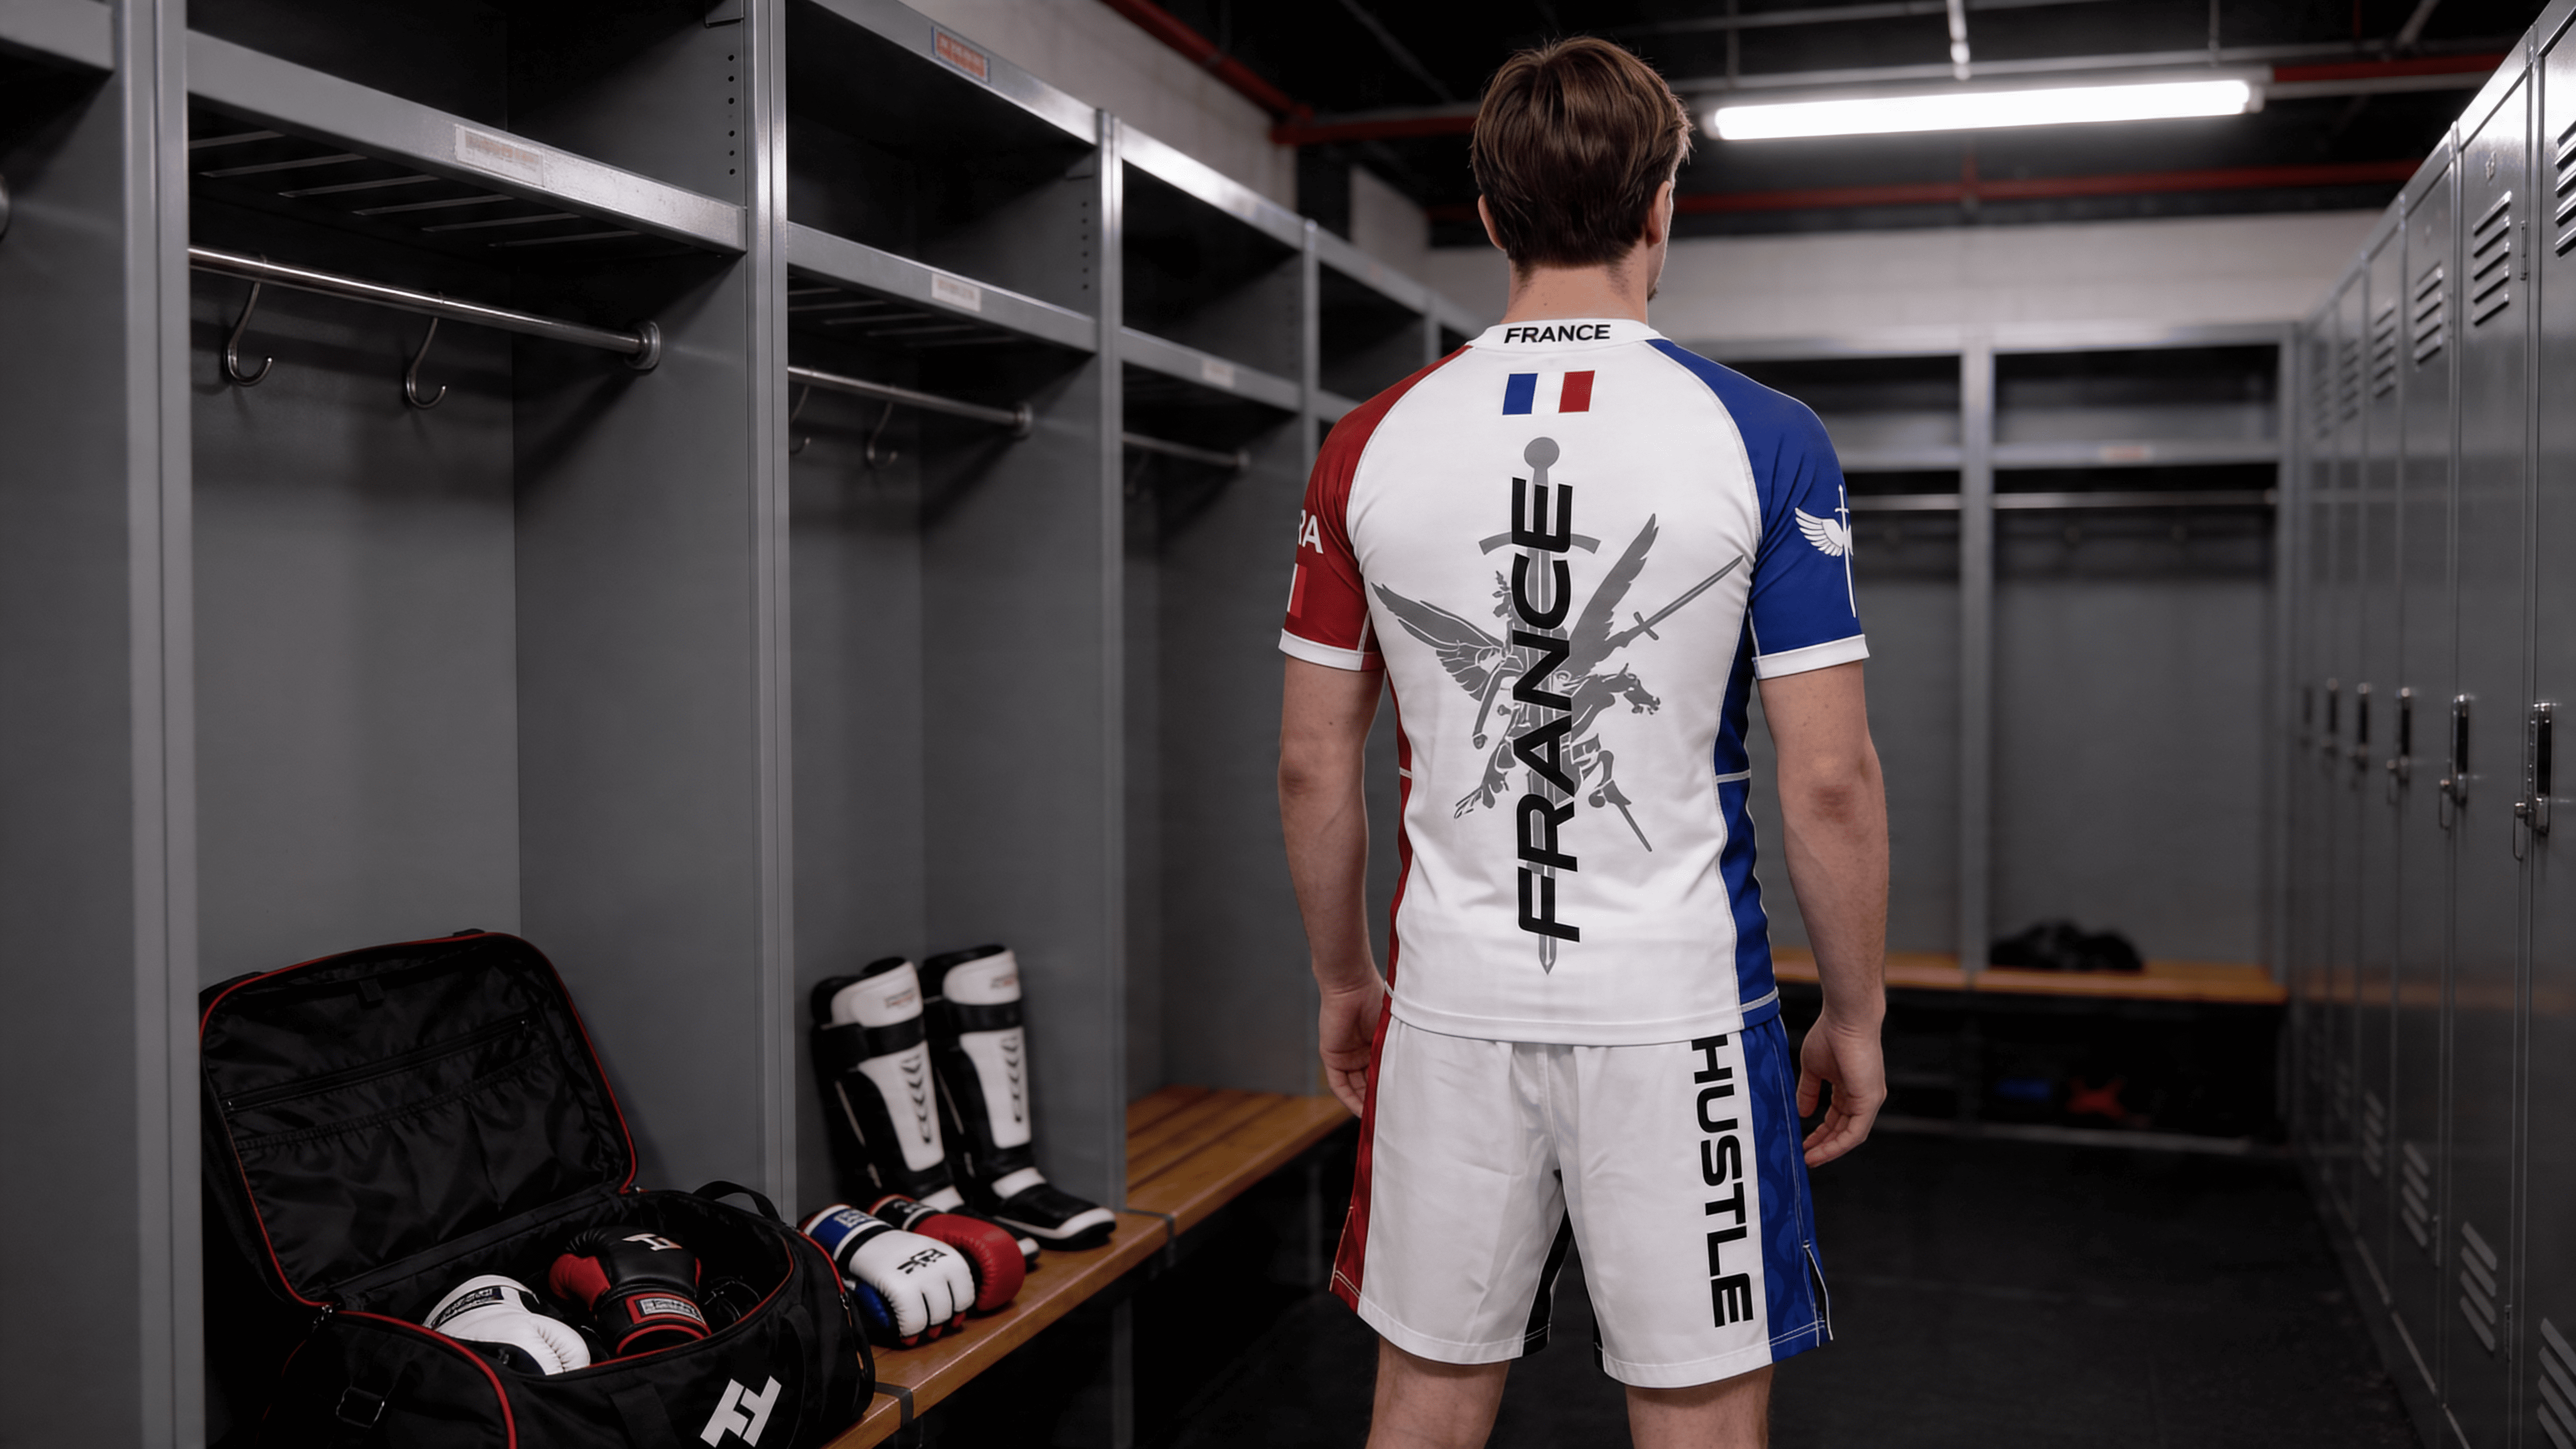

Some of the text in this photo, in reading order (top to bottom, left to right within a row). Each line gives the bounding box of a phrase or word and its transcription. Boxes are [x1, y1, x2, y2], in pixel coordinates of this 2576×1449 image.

[1504, 324, 1611, 344] FRANCE
[1511, 476, 1580, 942] FRANCE
[1691, 1033, 1754, 1328] HUSTLE
